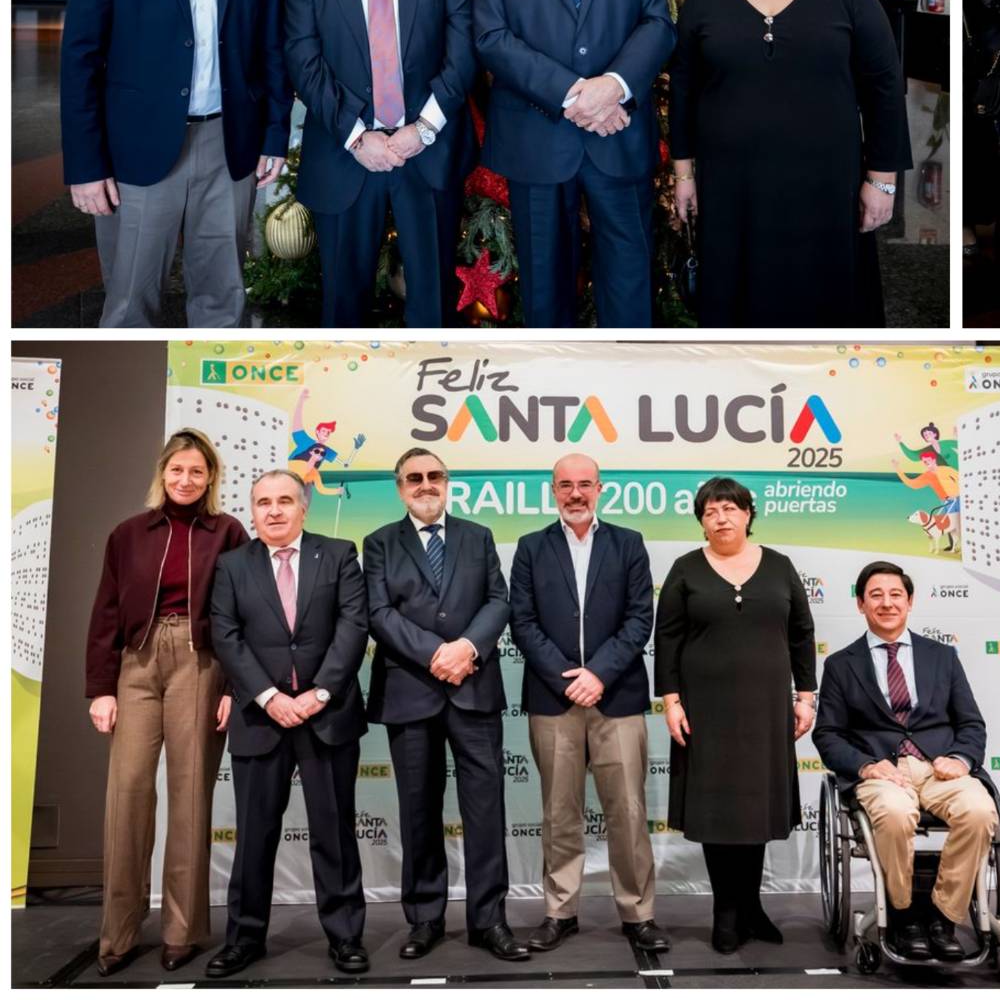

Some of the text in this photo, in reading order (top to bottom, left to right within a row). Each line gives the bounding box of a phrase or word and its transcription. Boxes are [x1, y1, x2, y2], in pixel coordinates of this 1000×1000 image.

[232, 365, 299, 382] ONCE
[416, 357, 519, 392] Feliz
[11, 382, 34, 390] NCE
[410, 383, 842, 444] SANTA LUCÍA
[787, 447, 843, 468] 2025
[446, 480, 553, 515] RAILL
[602, 480, 666, 515] 200
[764, 480, 847, 498] abriendo
[764, 497, 837, 516] puertas
[940, 590, 969, 598] ONCE
[360, 766, 388, 777] NCE
[284, 833, 309, 841] ONC
[356, 828, 387, 840] UCÍA
[511, 828, 542, 837] ONCE
